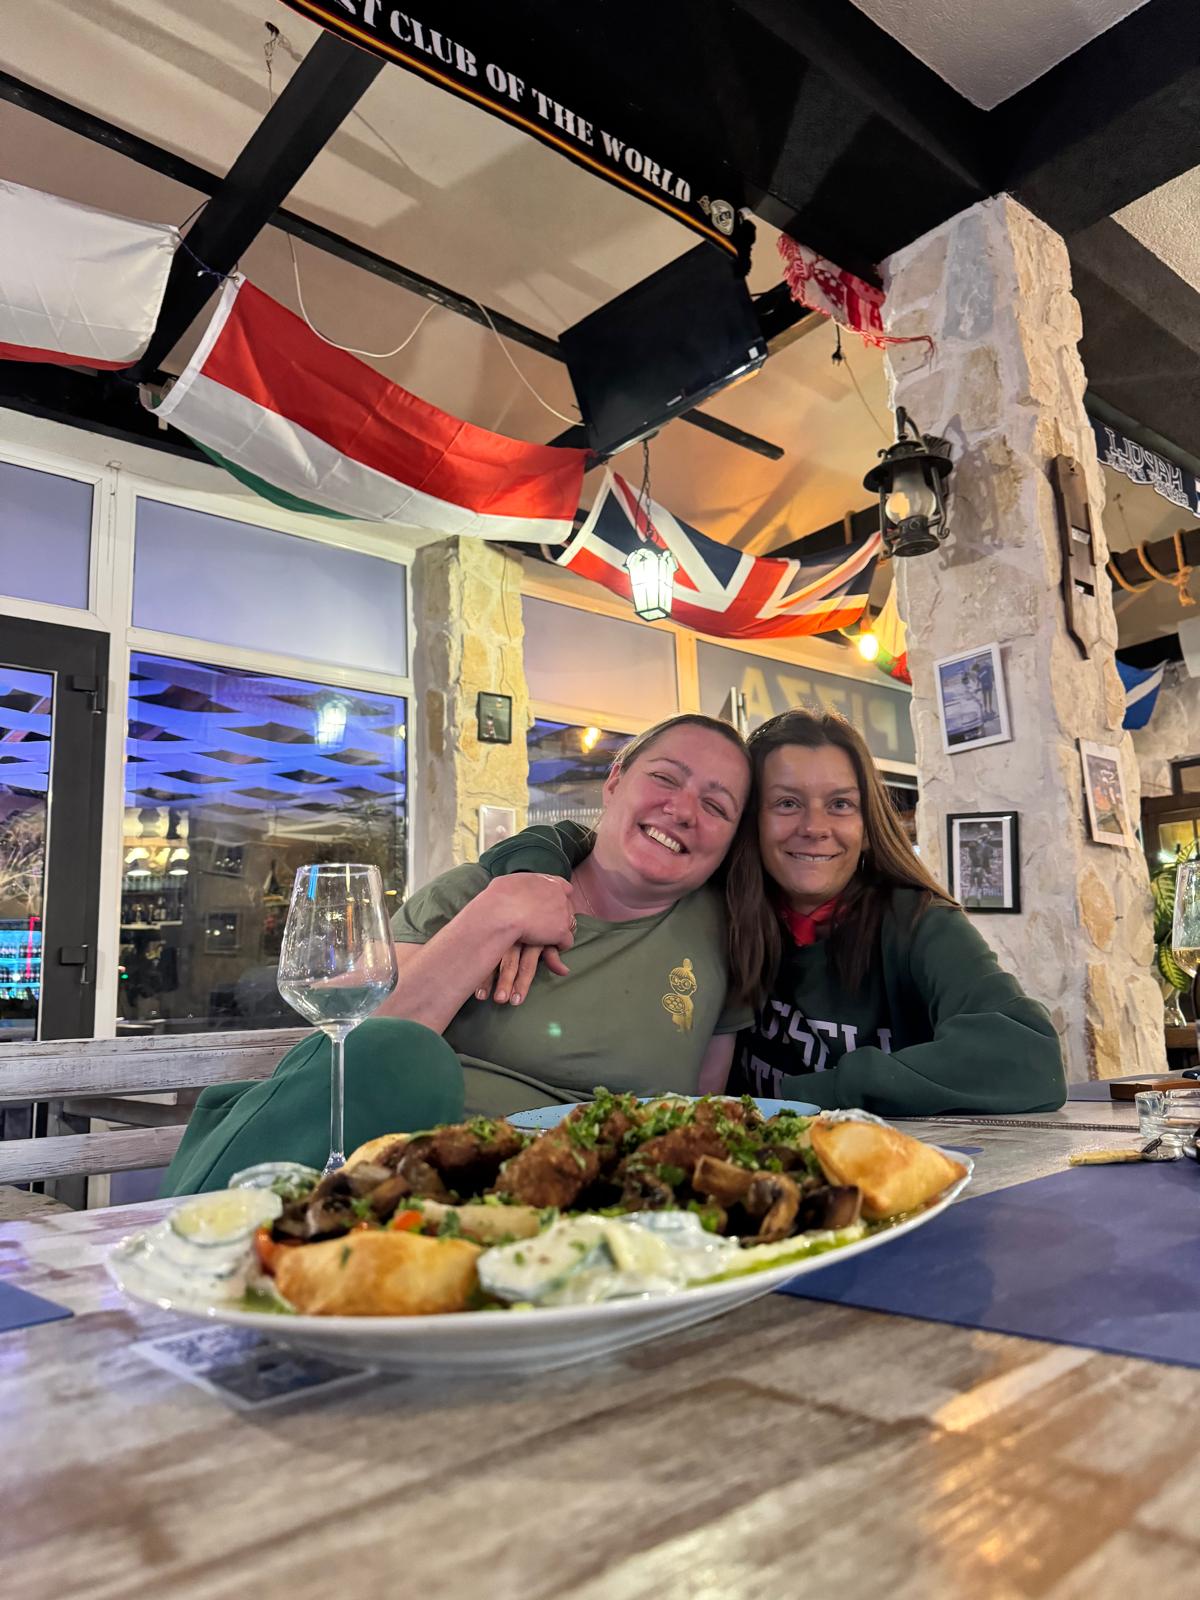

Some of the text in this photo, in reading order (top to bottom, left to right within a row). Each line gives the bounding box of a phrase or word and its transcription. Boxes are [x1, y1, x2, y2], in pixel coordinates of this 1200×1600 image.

[390, 10, 478, 77] CLUB
[486, 62, 525, 101] OF
[531, 88, 595, 147] THE
[600, 130, 692, 203] WORLD
